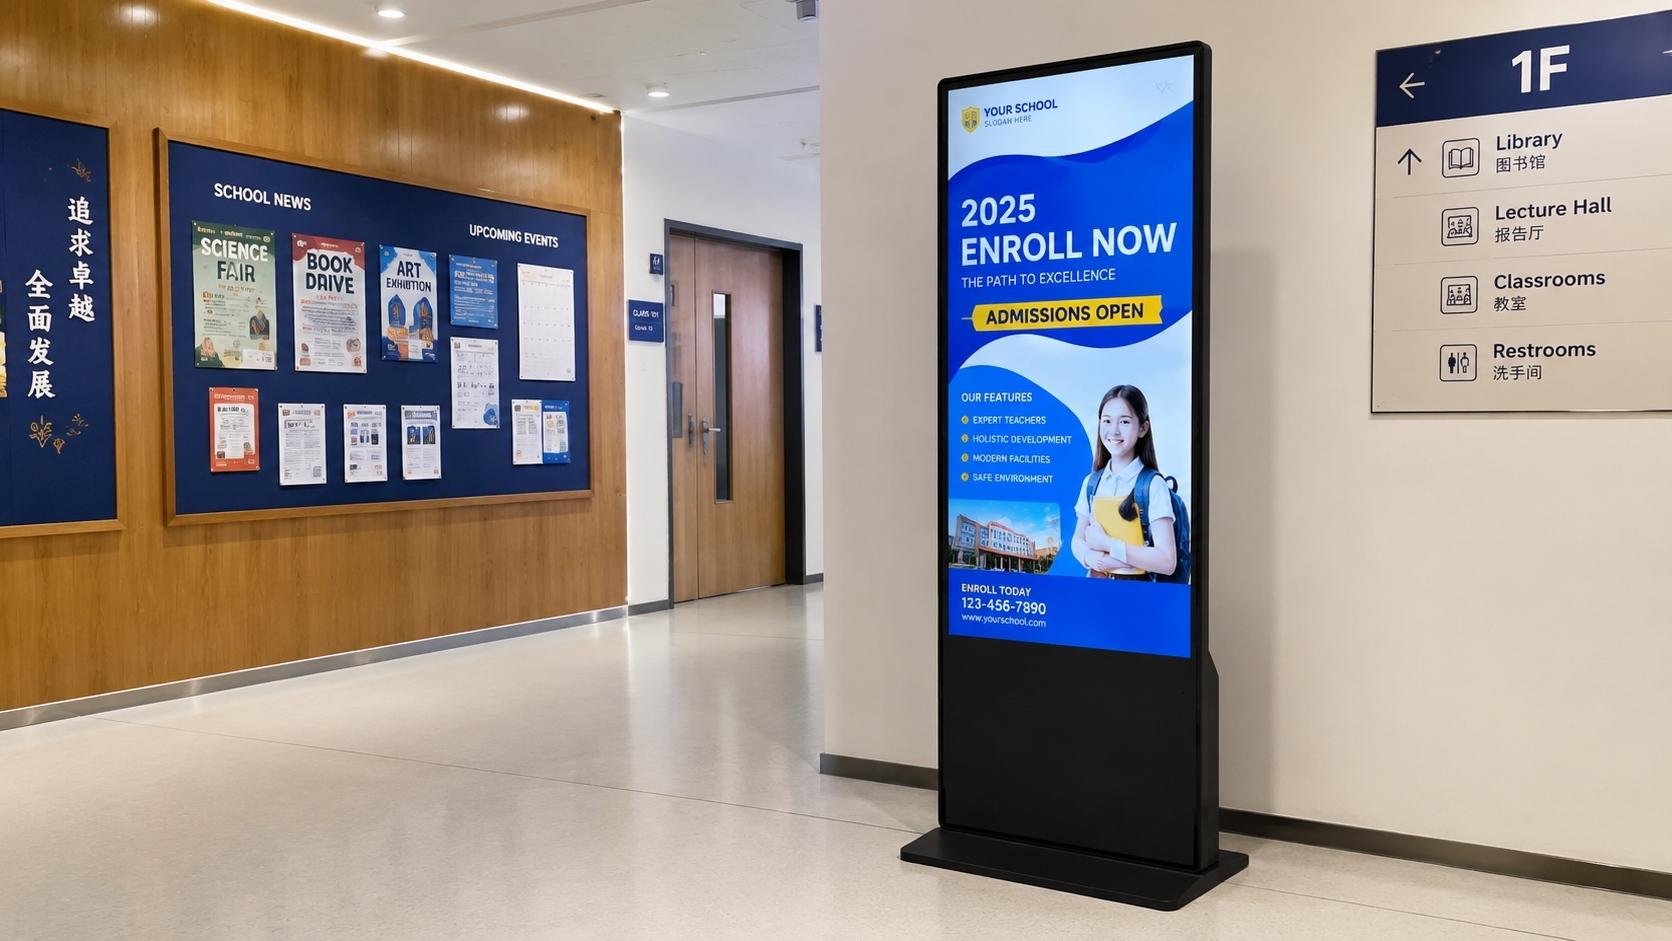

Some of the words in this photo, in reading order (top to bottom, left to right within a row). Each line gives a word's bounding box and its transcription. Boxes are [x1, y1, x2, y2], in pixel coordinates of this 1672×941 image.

[1511, 44, 1570, 94] 1F
[984, 105, 1012, 118] YOUR
[1014, 98, 1058, 114] SCHOOL
[984, 117, 1013, 128] SLOGAN
[1014, 115, 1032, 124] HERE
[1496, 132, 1563, 151] Library
[1496, 154, 1546, 173] 图书馆
[214, 182, 270, 205] SCHOOL
[274, 193, 312, 211] NEWS
[961, 193, 1036, 227] 2025
[1495, 203, 1567, 221] Lecture
[1573, 196, 1612, 216] Hall
[469, 224, 522, 243] UPCOMING
[524, 234, 559, 249] EVENTS
[1494, 225, 1544, 243] 报告厅
[200, 237, 269, 262] SCIENCE
[961, 230, 1082, 267] ENROLL
[1092, 222, 1177, 257] NOW
[68, 196, 96, 322] 追求卓越
[307, 252, 354, 274] BOOK
[217, 261, 256, 282] FAIR
[397, 260, 422, 278] ART
[961, 276, 983, 289] THE
[986, 274, 1017, 287] PATH
[1019, 273, 1036, 285] TO
[1039, 268, 1116, 284] EXCELLENCE
[305, 272, 356, 294] DRIVE
[1494, 271, 1606, 289] Classrooms
[1493, 296, 1527, 312] 教室
[986, 305, 1091, 325] ADMISSIONS
[1095, 303, 1144, 322] OPEN
[26, 269, 56, 399] 全面发展
[1493, 342, 1596, 358] Restrooms
[1493, 365, 1543, 381] 洗手间
[961, 392, 982, 402] OUR
[984, 392, 1033, 402] FEATURES
[973, 415, 1003, 425] EXPERT
[1005, 415, 1047, 425] TEACHERS
[973, 434, 1009, 444] HOLISTIC
[1011, 435, 1072, 445] DEVELOPMENT
[973, 454, 1008, 463] MODERN
[1009, 454, 1051, 464] FACILITIES
[973, 473, 993, 482] SAFE
[995, 473, 1053, 484] ENVIRONMENT
[961, 583, 998, 595] ENROLL
[999, 585, 1032, 597] TODAY
[961, 596, 1046, 615] 123-456-7890
[961, 613, 1046, 628] www.yourschool.com
